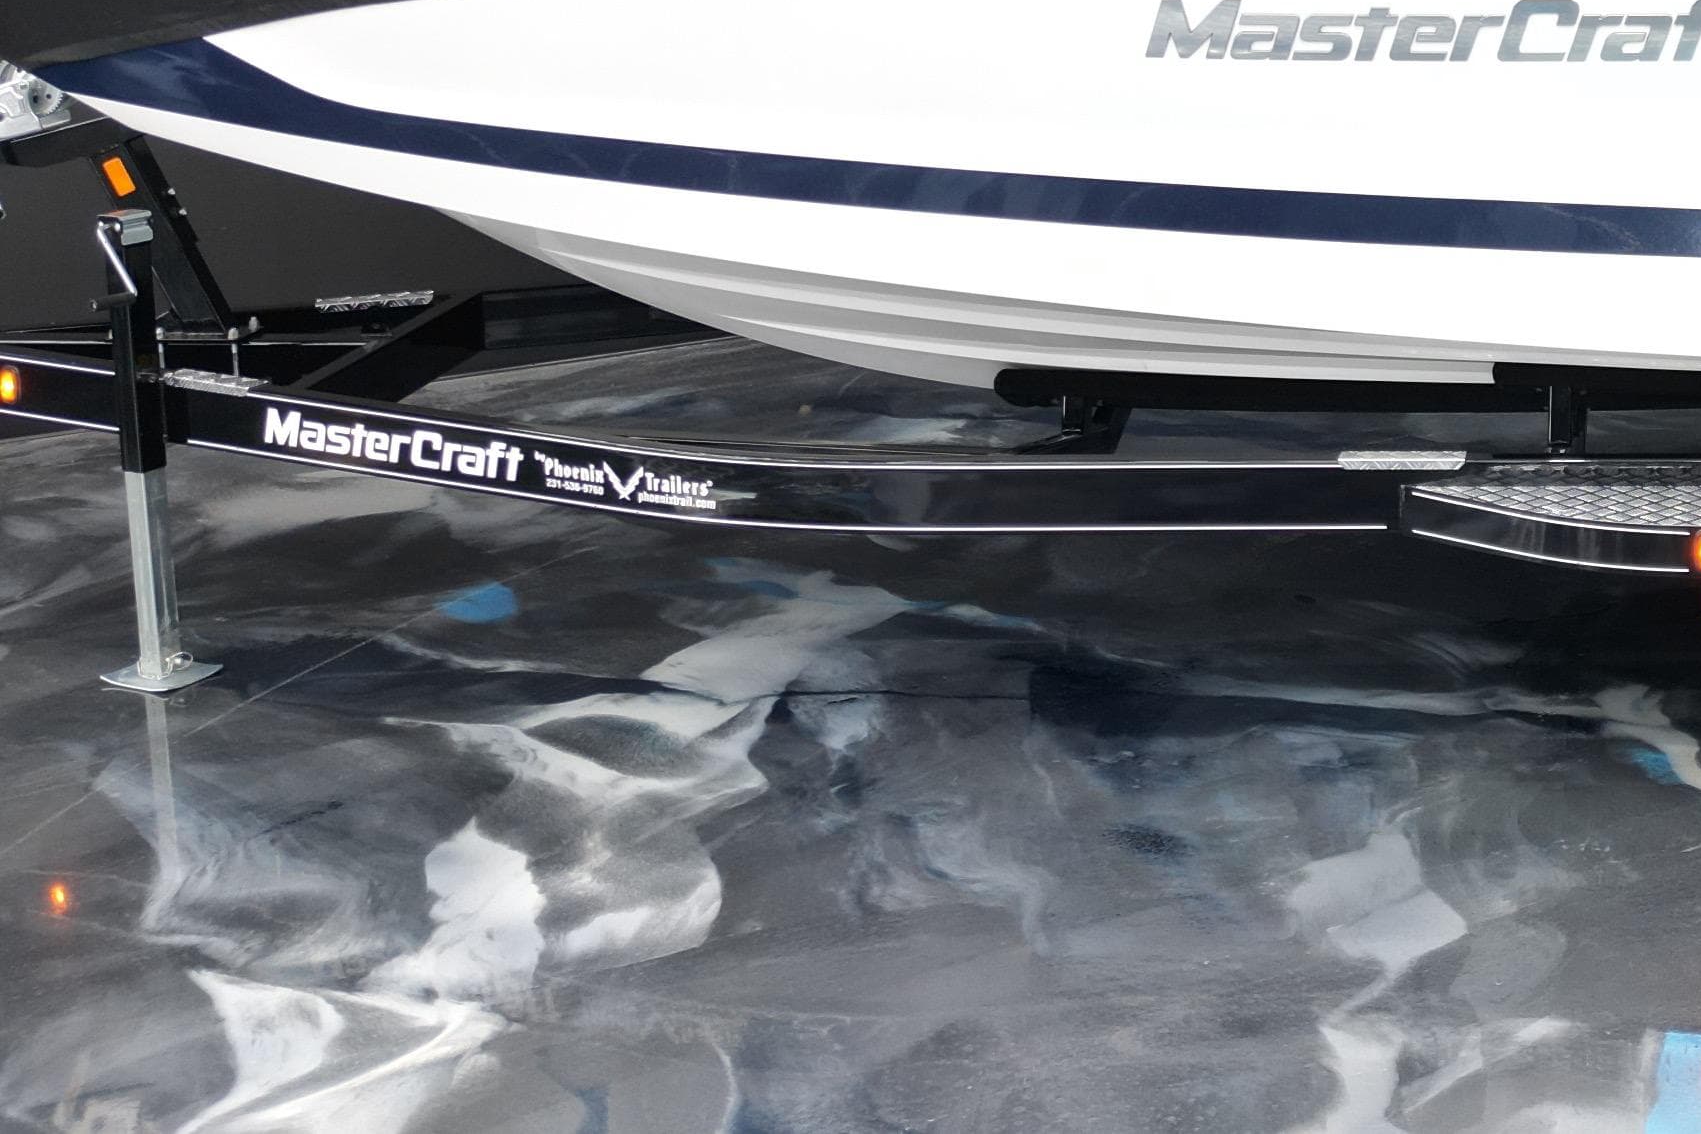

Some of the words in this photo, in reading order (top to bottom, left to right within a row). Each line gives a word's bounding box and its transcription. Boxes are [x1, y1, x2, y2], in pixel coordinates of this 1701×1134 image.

[264, 407, 524, 482] MasterCraft
[544, 457, 605, 485] Phoenix
[644, 471, 710, 497] Trailers
